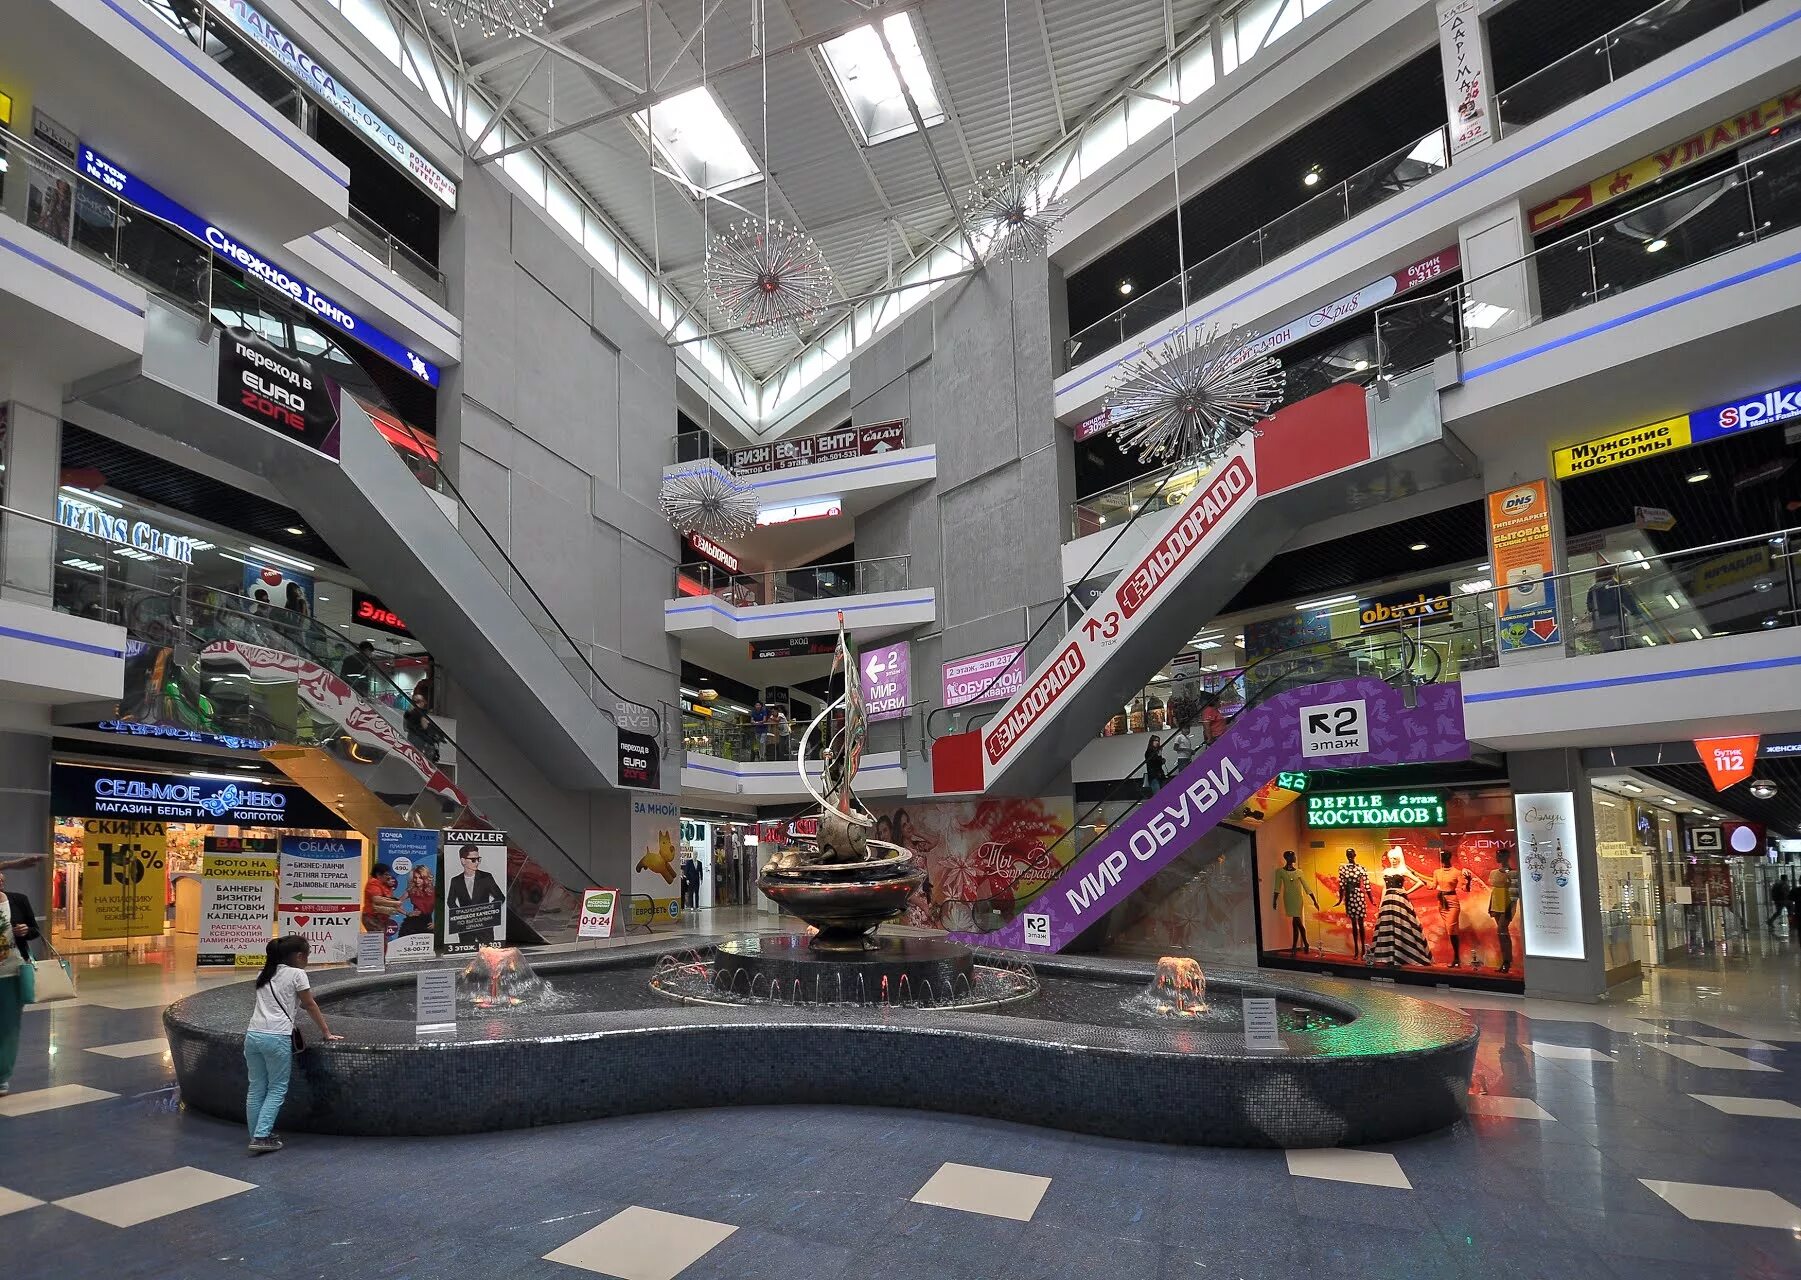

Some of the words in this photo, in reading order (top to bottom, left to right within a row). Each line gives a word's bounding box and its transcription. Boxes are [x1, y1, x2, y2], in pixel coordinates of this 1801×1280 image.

[341, 94, 405, 155] 21-07-08
[1459, 126, 1482, 142] 432
[86, 150, 93, 161] 3
[96, 158, 127, 183] этаж
[103, 174, 124, 191] 309
[1407, 257, 1441, 277] бутик
[205, 226, 303, 298] Снежное
[305, 287, 355, 330] Танго
[236, 342, 301, 388] переход
[302, 377, 313, 391] в
[242, 370, 305, 412] EURO
[241, 388, 305, 432] ZONE
[1750, 413, 1774, 428] Man's
[862, 428, 903, 443] GALAXY
[1571, 427, 1670, 460] Мужские
[1571, 437, 1673, 471] костюмы
[788, 458, 809, 468] этаж
[1506, 495, 1532, 508] DNS
[1493, 512, 1548, 529] ГИПЕРМАРКЕТ
[1493, 524, 1550, 543] БЫТОВАЯ
[1102, 611, 1120, 639] 3
[789, 637, 809, 646] ВХОД
[1101, 639, 1118, 648] этаж
[887, 651, 898, 669] 2
[979, 660, 995, 671] зал
[996, 654, 1013, 665] 237
[959, 669, 1022, 694] ОБУВНОЙ
[870, 682, 897, 699] МИР
[1334, 707, 1359, 737] 2
[620, 742, 645, 754] переход
[1310, 738, 1360, 751] этаж
[1714, 748, 1742, 757] бутик
[623, 756, 647, 769] EURO
[1714, 756, 1745, 772] 112
[95, 778, 201, 803] СЕДЬМОЕ
[238, 790, 287, 808] НЕБО
[634, 802, 646, 813] ЗА
[647, 802, 678, 816] МНОЙ!
[1310, 795, 1383, 809] DEFILE
[1399, 796, 1408, 804] 2
[1409, 796, 1438, 804] этаж
[95, 801, 152, 815] МАГАЗИН
[157, 806, 193, 818] БЕЛЬЯ
[196, 809, 205, 818] И
[233, 810, 285, 822] КОЛГОТОК
[1308, 808, 1430, 825] КОСТЮМОВ
[447, 831, 504, 842] KANZLER
[1065, 850, 1128, 915] МИР
[1129, 756, 1244, 861] ОБУВИ
[251, 860, 267, 868] НА
[293, 862, 345, 870] БИЗНЕС-ЛАНЧИ
[204, 868, 276, 877] ДОКУМЕНТЫ
[216, 885, 263, 893] БАННЕРЫ
[292, 882, 328, 890] ДЫМОВЫЕ
[216, 894, 261, 902] ВИЗИТКИ
[207, 912, 268, 920] КАЛЕНДАРИ
[286, 917, 291, 926] I
[312, 917, 352, 926] ITALY
[1037, 917, 1047, 932] 2
